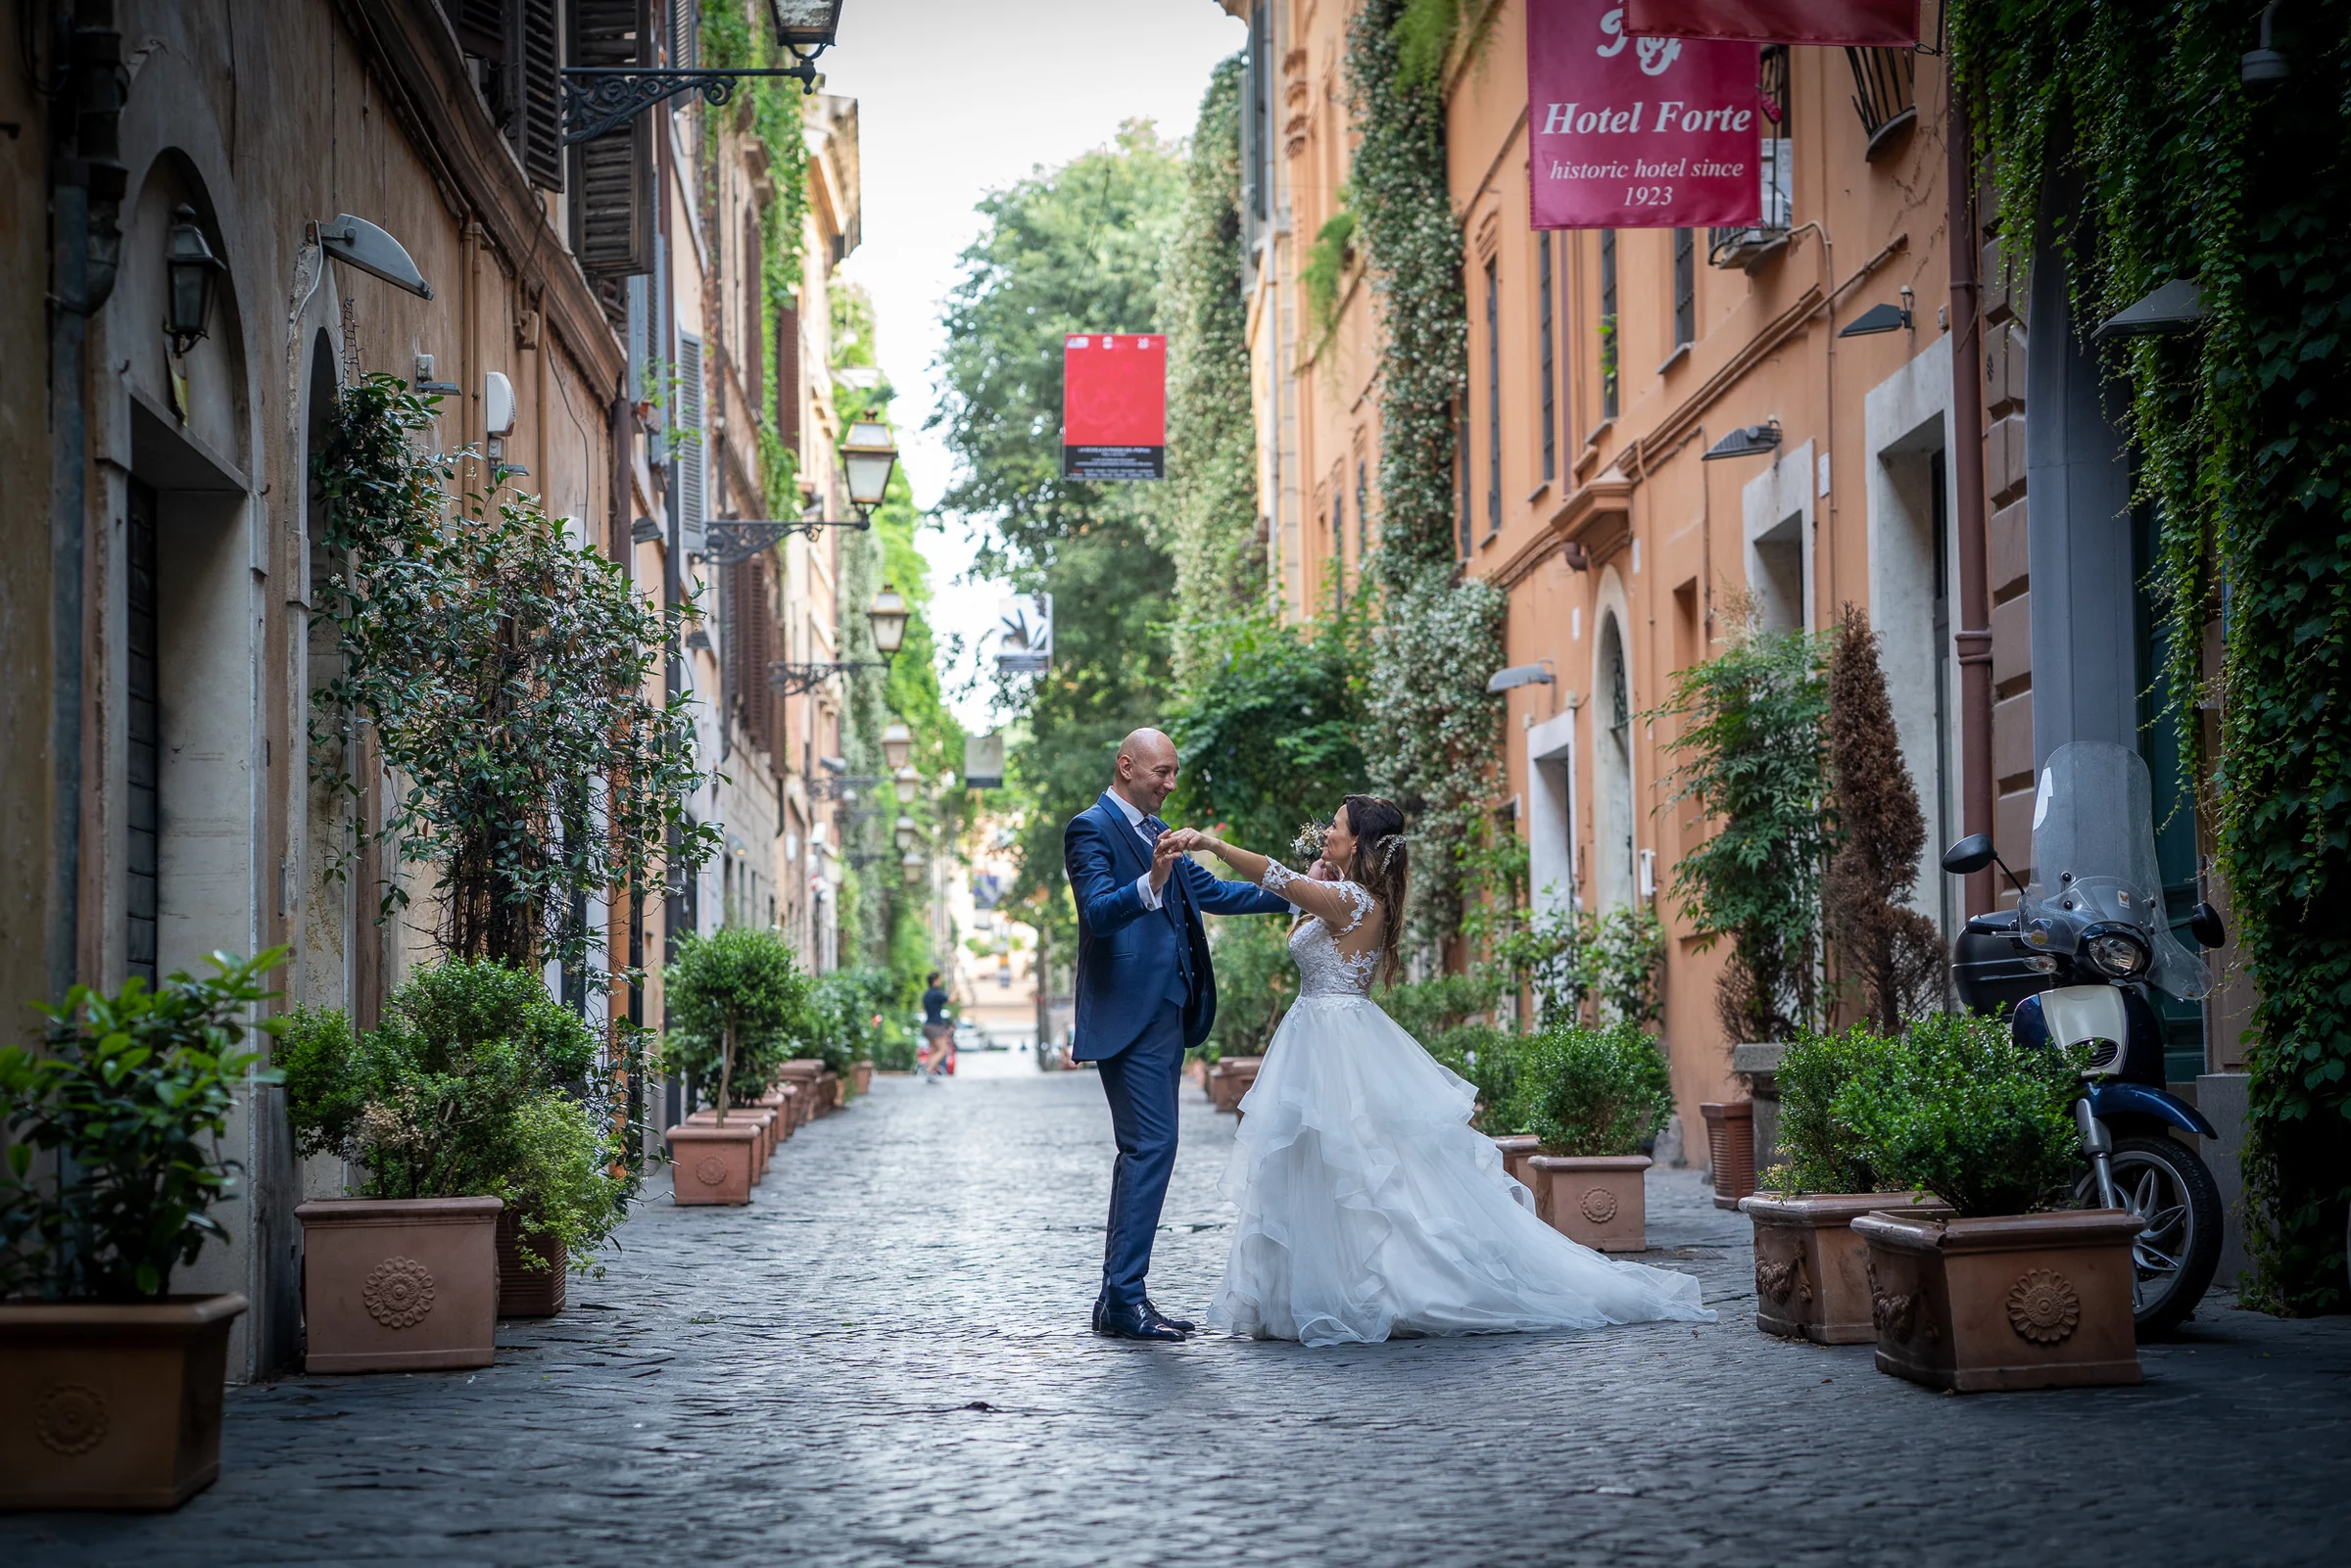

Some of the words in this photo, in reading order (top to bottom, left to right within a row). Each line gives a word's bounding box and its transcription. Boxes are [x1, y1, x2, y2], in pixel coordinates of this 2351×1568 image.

[1540, 101, 1644, 134] Hotel
[1652, 101, 1752, 133] Forte
[1550, 160, 1629, 179] historic
[1634, 158, 1687, 178] hotel
[1690, 159, 1745, 177] since
[1623, 186, 1674, 206] 1923
